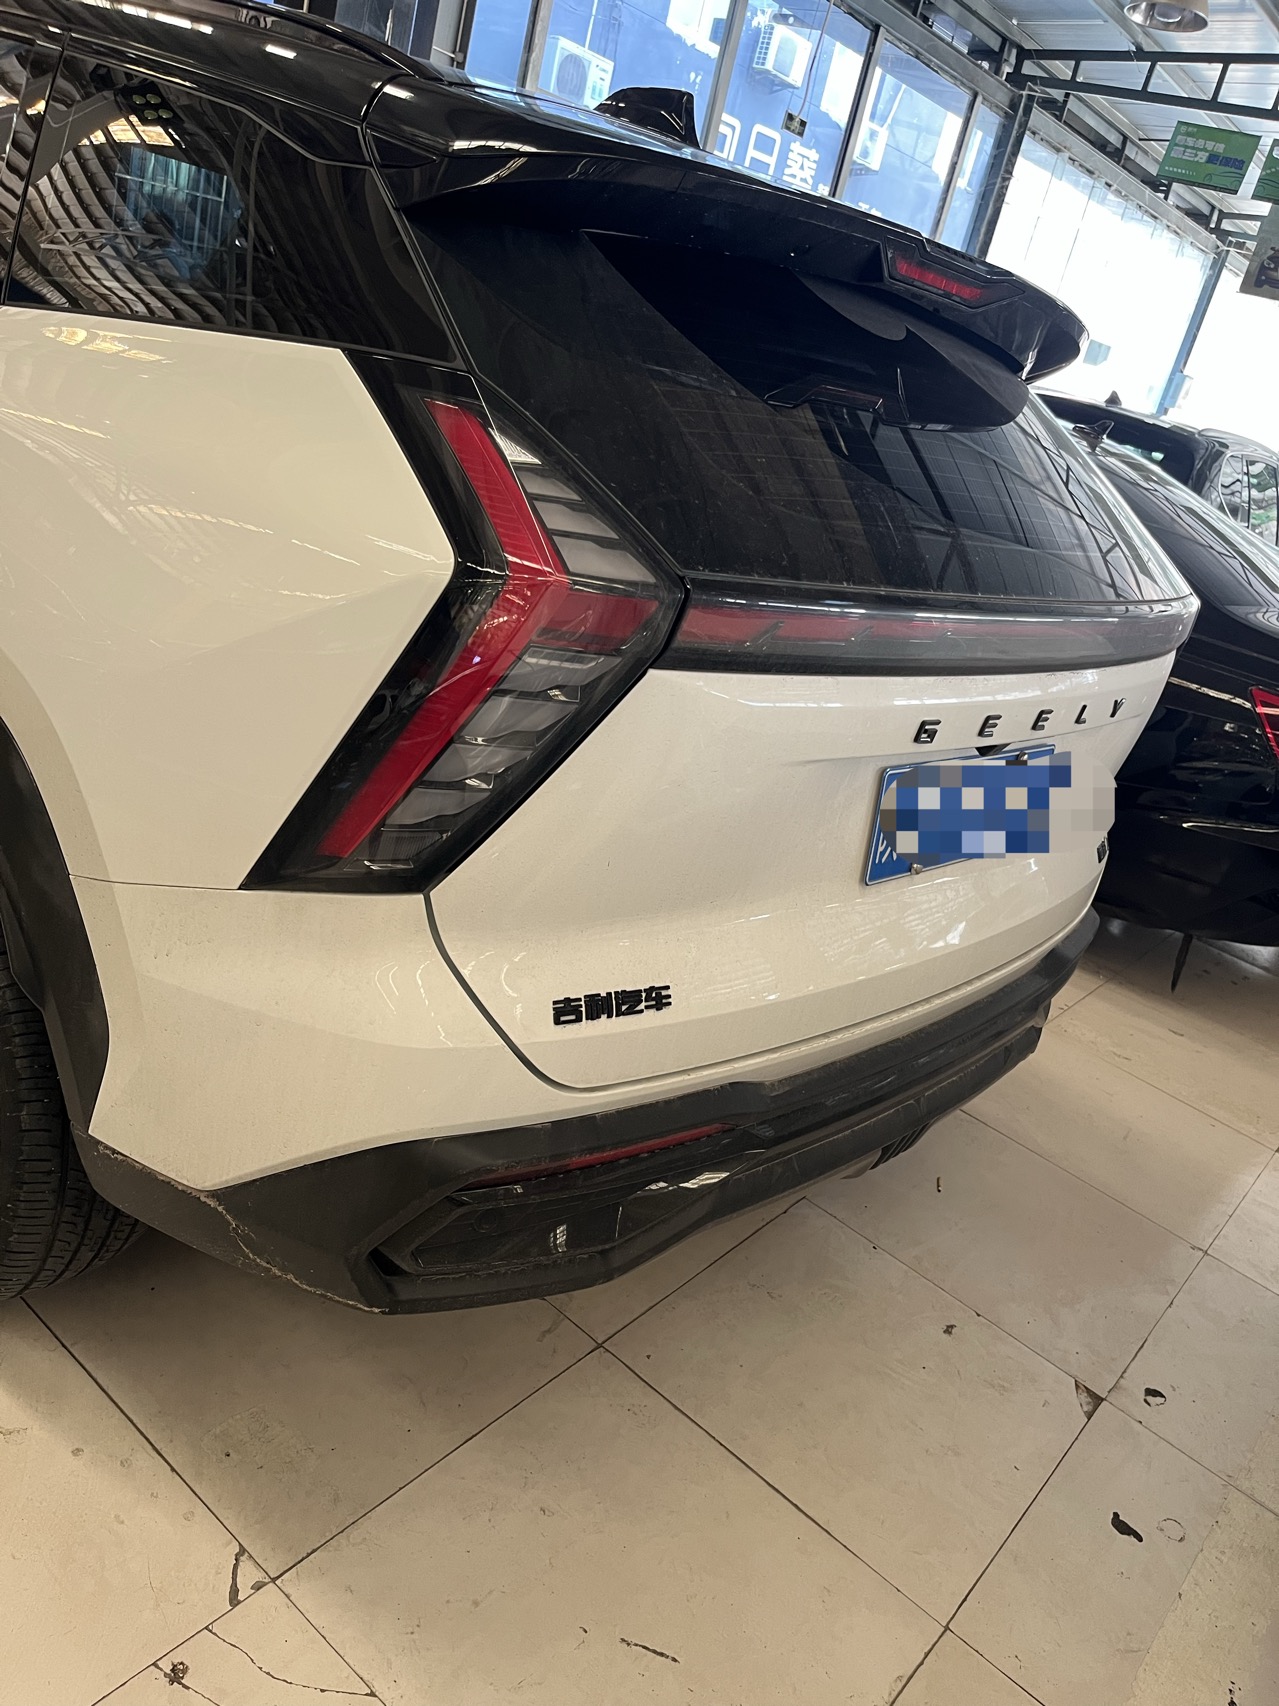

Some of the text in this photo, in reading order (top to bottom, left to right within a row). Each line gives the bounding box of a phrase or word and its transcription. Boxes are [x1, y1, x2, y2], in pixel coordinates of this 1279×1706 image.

[913, 697, 1126, 745] GEELY
[552, 984, 672, 1026] 吉利汽车
